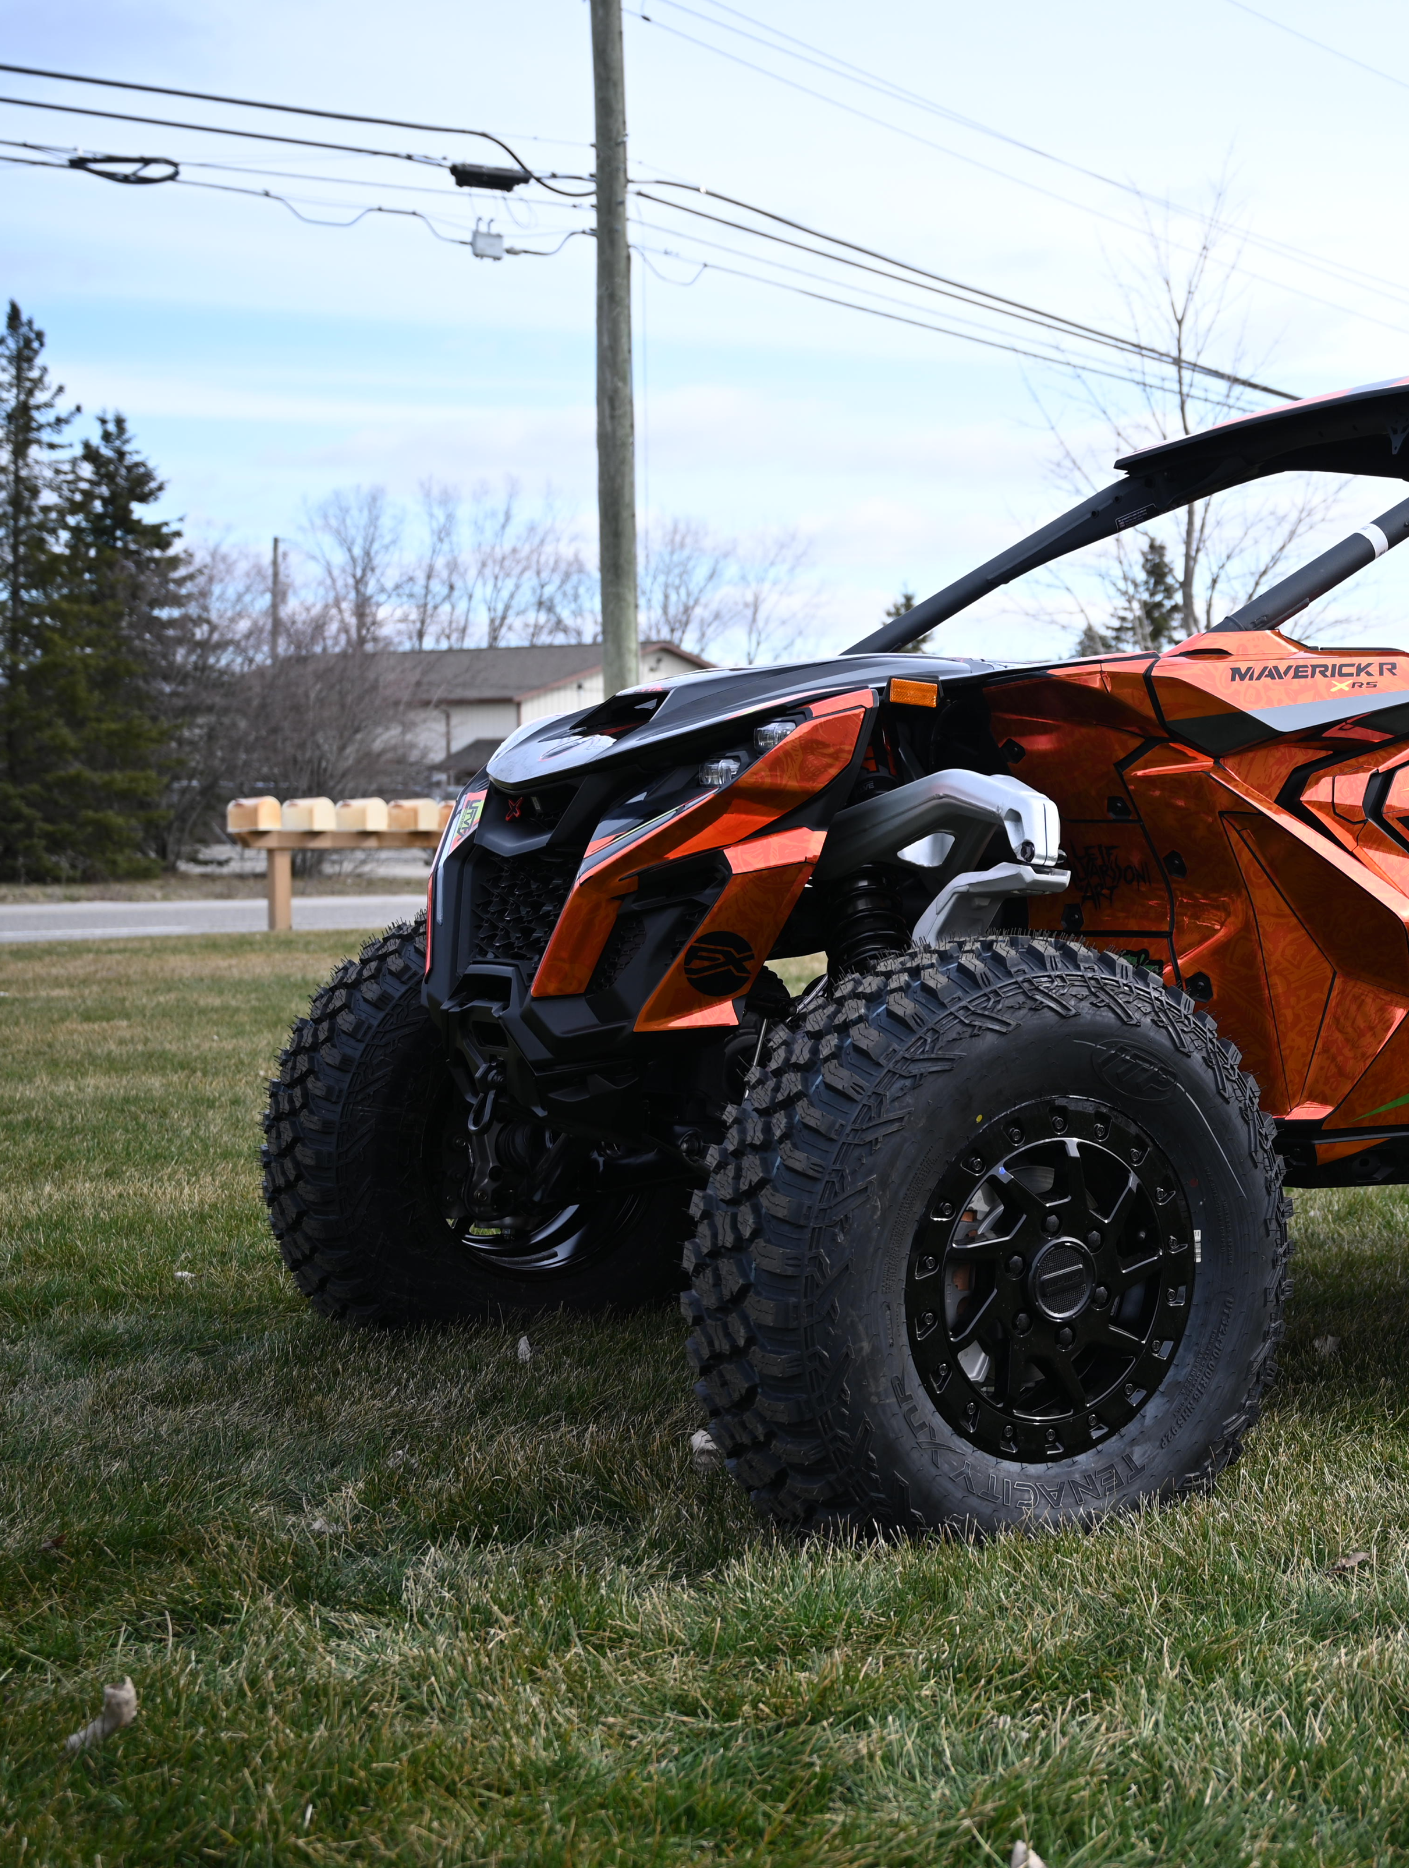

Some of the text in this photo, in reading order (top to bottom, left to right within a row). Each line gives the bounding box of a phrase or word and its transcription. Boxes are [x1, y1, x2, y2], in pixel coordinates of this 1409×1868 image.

[1230, 662, 1398, 682] MAVERICK R
[1097, 1044, 1178, 1091] ITP
[949, 1453, 1146, 1509] TENACITY
